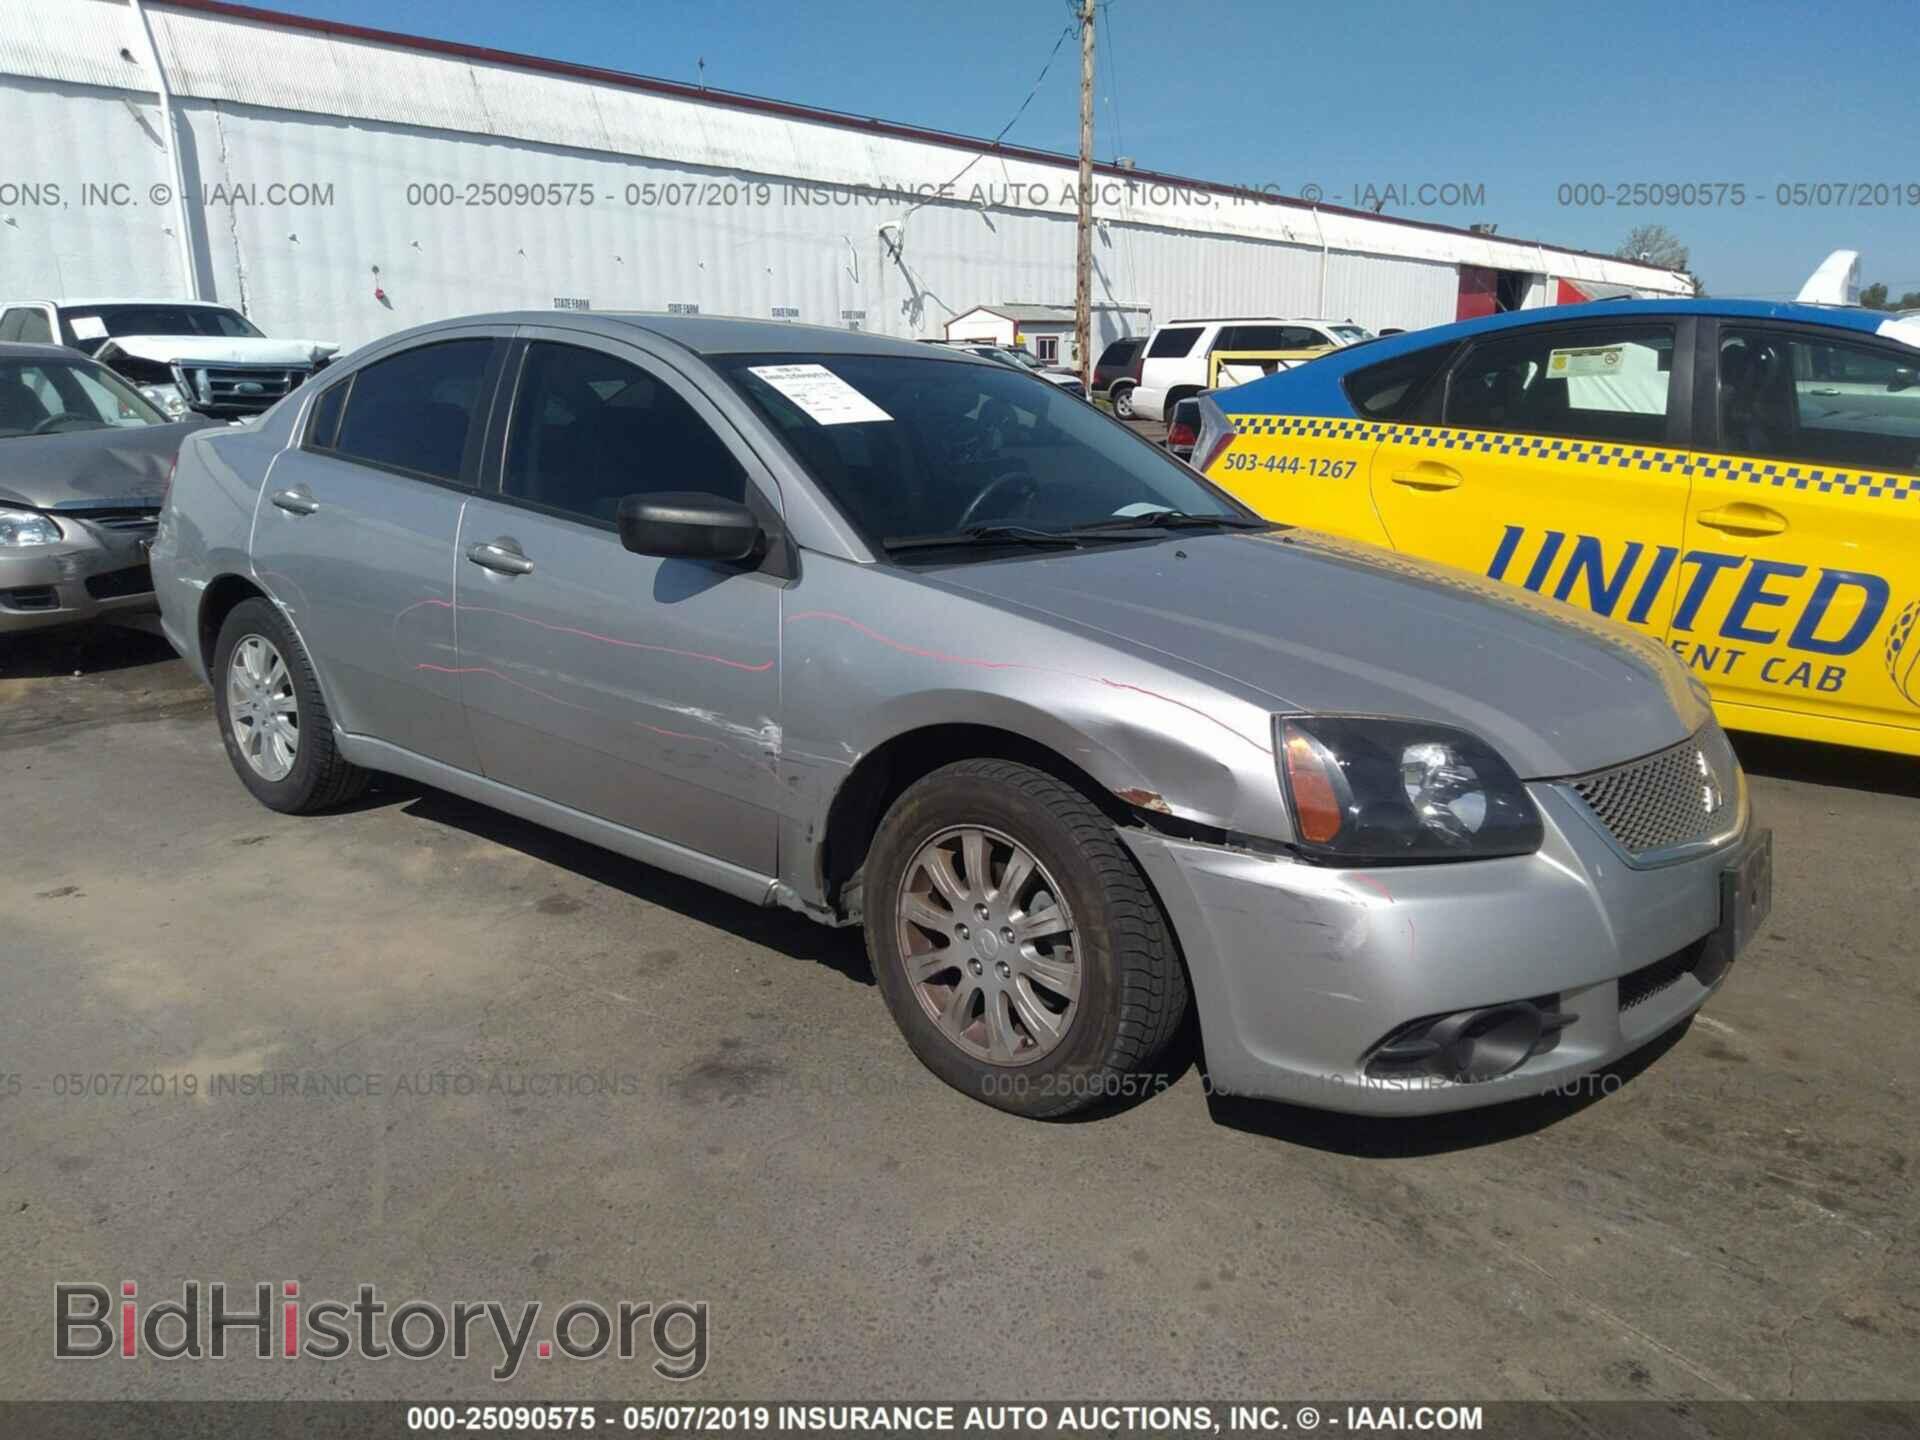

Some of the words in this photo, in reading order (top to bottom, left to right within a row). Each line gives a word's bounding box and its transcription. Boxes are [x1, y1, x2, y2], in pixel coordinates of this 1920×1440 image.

[1224, 453, 1358, 480] 503-444-1267
[1486, 524, 1891, 656] UNITED
[1760, 657, 1847, 693] CAB
